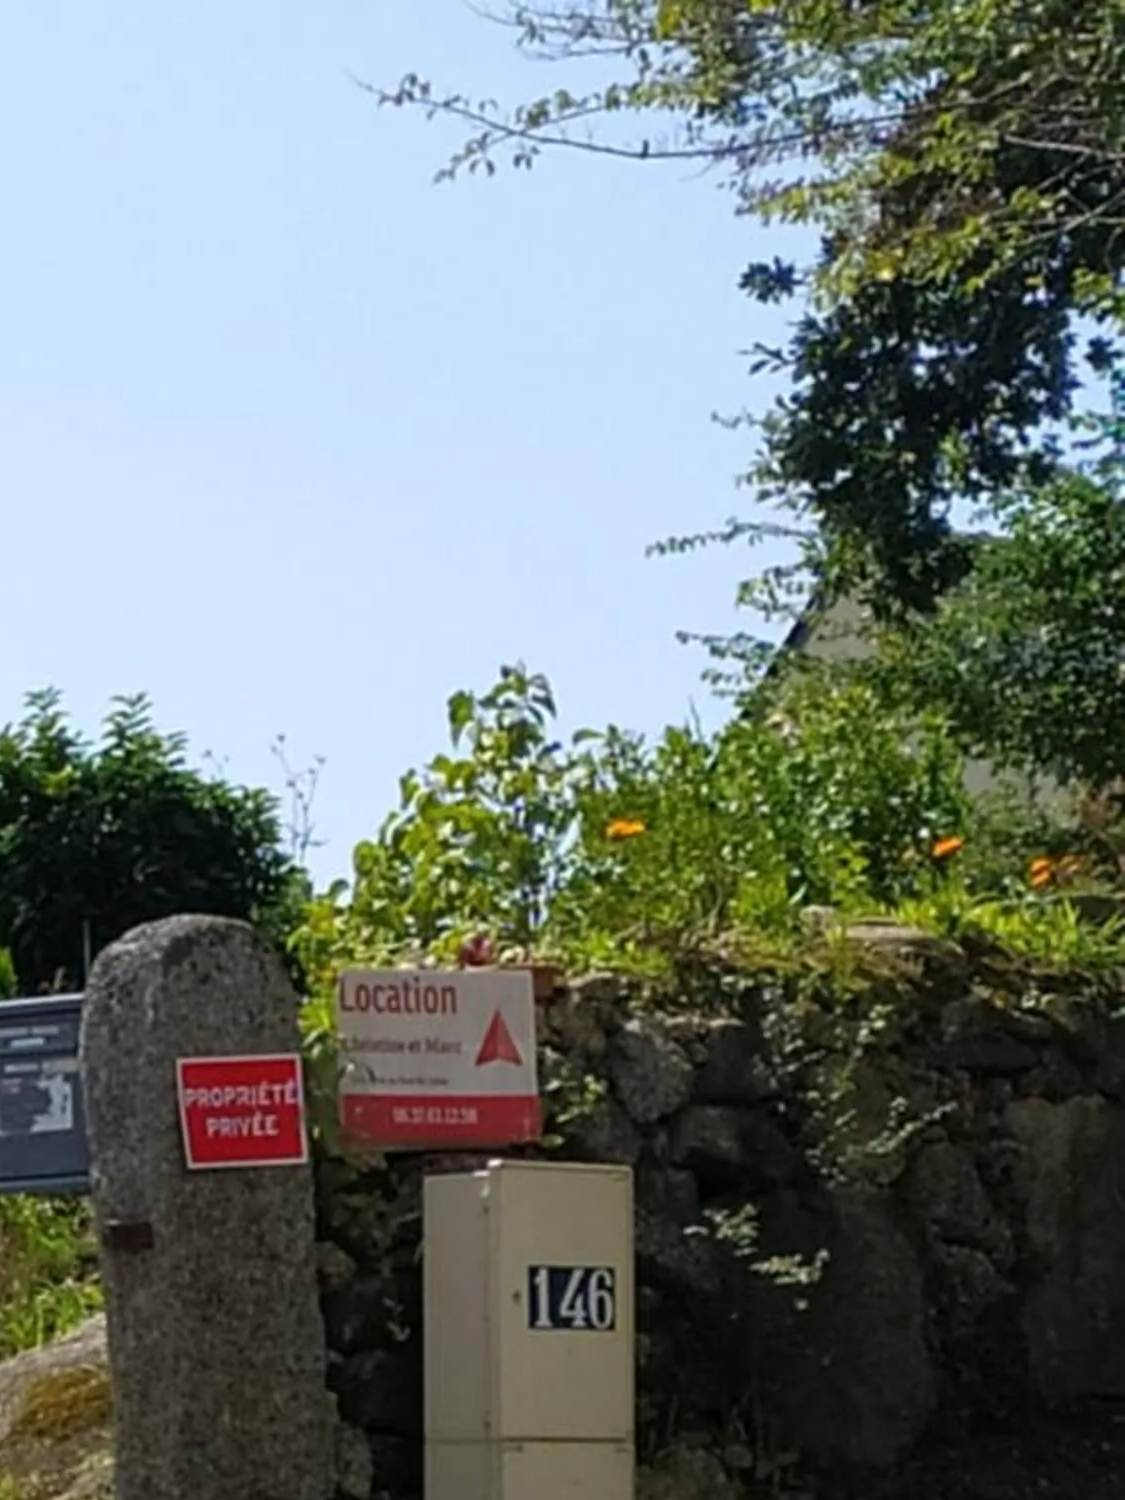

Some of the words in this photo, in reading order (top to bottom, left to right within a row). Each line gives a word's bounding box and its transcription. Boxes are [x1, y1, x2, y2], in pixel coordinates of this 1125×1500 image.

[340, 976, 458, 1015] Location
[183, 1077, 297, 1108] PROPRIÉTÉ
[206, 1110, 280, 1138] PRIVÉE
[533, 1266, 614, 1330] 146
